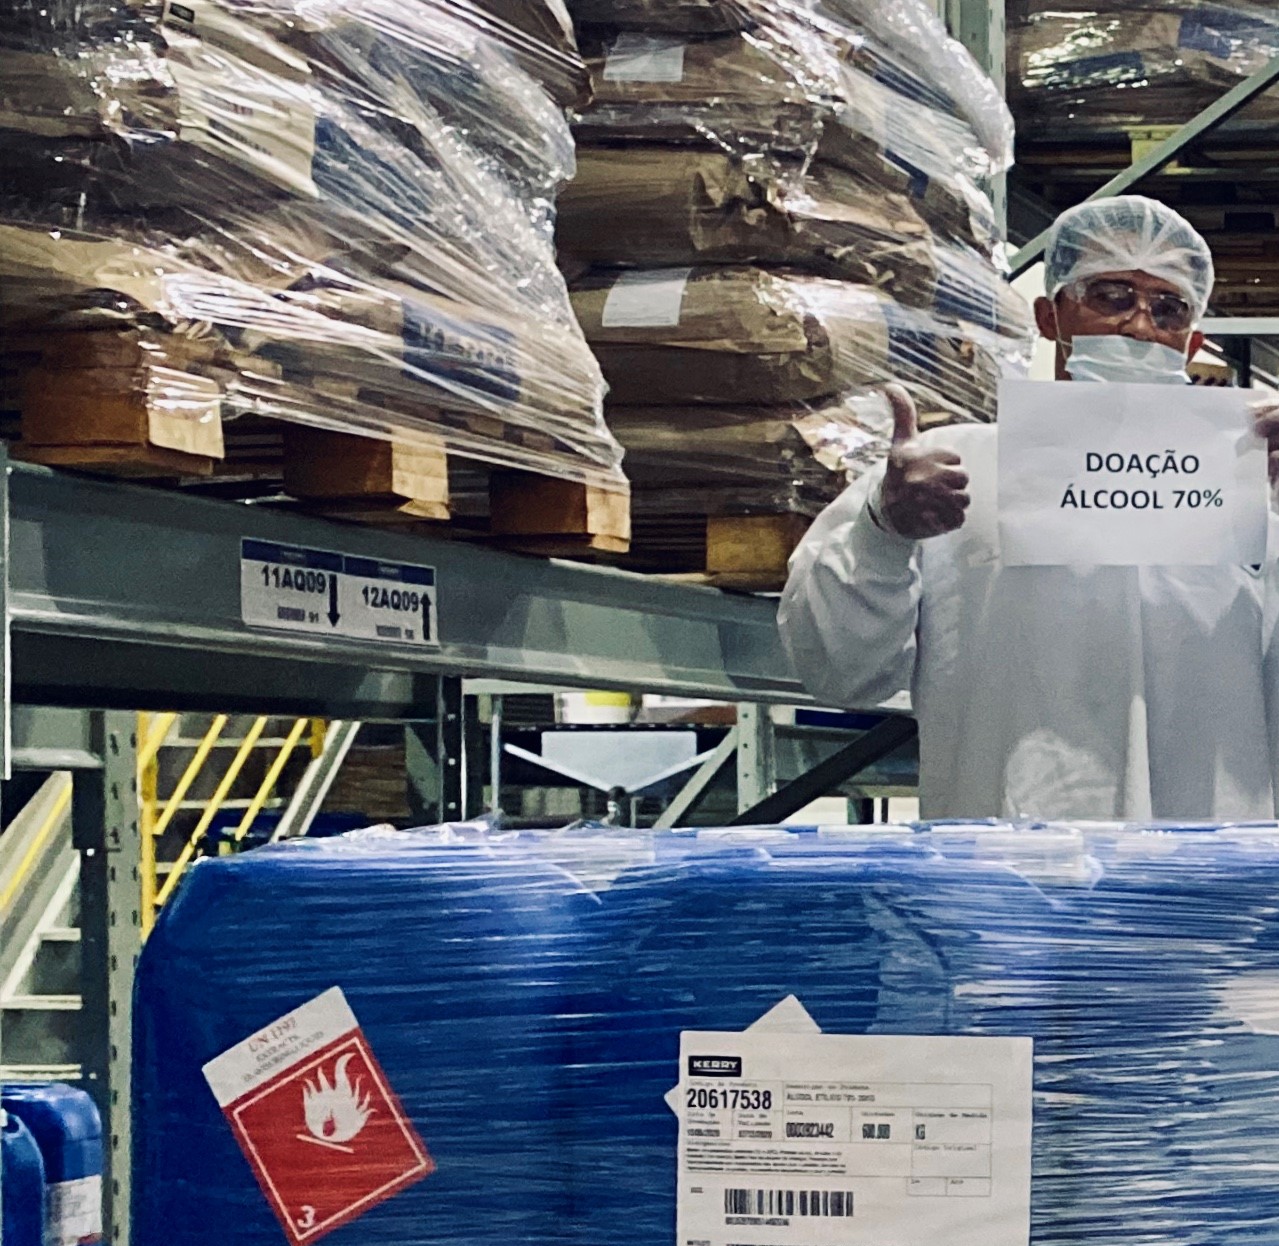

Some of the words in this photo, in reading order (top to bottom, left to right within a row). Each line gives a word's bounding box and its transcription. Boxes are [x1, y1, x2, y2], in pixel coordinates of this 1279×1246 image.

[1086, 449, 1200, 479] DOAÇÃO
[1060, 483, 1164, 509] ÁLCOOL
[1172, 488, 1223, 509] 70%
[262, 564, 327, 594] 11AQ09
[362, 585, 419, 612] 12AQ09
[692, 1060, 739, 1070] KERRY
[686, 1088, 773, 1111] 20617538
[297, 1205, 316, 1229] 3
